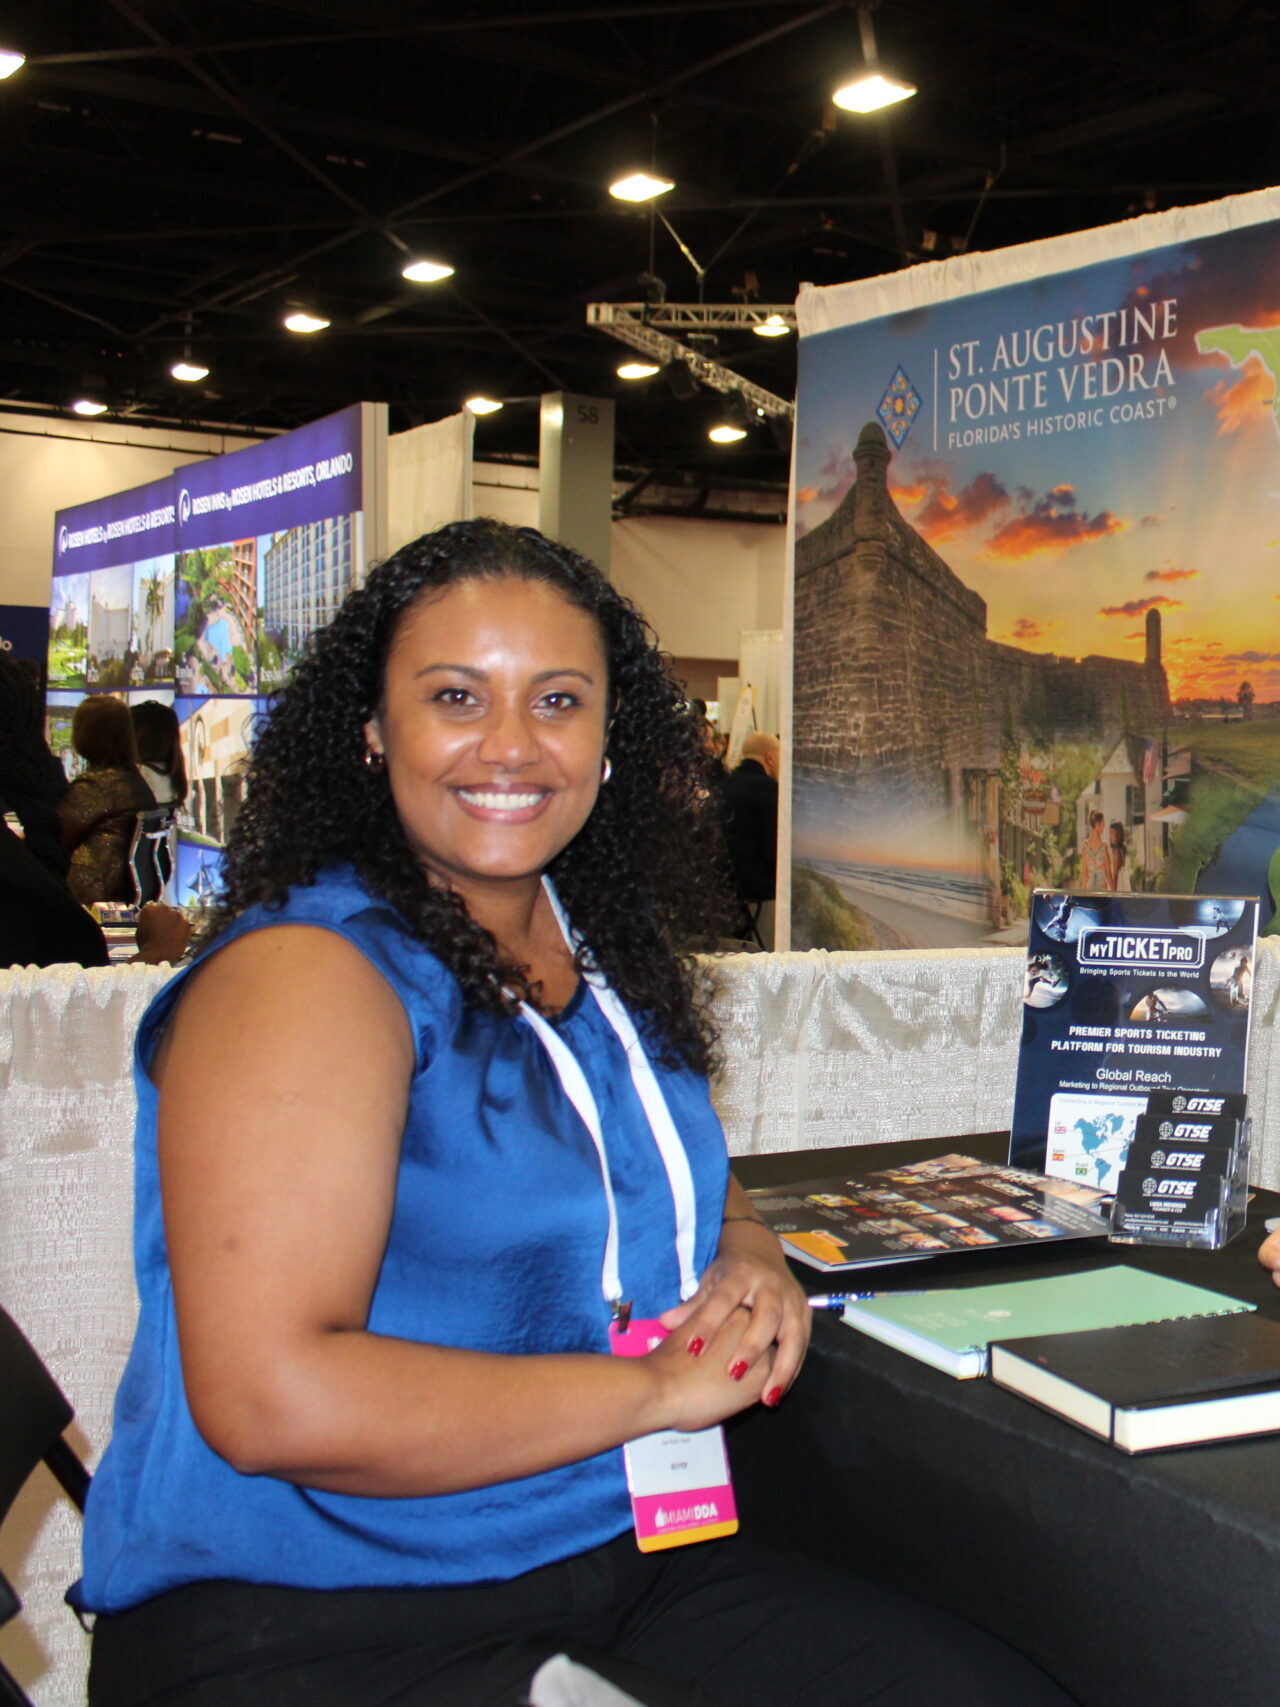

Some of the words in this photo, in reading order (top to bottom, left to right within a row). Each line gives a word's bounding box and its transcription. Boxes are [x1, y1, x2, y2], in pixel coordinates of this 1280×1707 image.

[948, 340, 983, 381] ST.
[991, 298, 1178, 372] AUGUSTINE
[949, 370, 1048, 423] PONTE
[1057, 347, 1176, 403] VEDRA
[577, 404, 599, 424] 58
[949, 421, 1021, 449] FLORIDA'S
[1027, 408, 1104, 437] HISTORIC
[252, 477, 278, 501] HOTELS
[315, 452, 353, 482] ORLANDO
[1080, 967, 1107, 976] Bringing
[1109, 968, 1131, 977] Sports
[1132, 969, 1156, 977] Tickets
[1167, 970, 1178, 978] the
[1180, 971, 1200, 979] World
[1069, 1026, 1112, 1037] PREMIER
[1114, 1027, 1153, 1039] SPORTS
[1156, 1029, 1206, 1042] TICKETING
[1051, 1040, 1103, 1051] PLATFORM
[1105, 1043, 1125, 1053] FOR
[1128, 1044, 1171, 1055] TOURISM
[1173, 1045, 1222, 1058] INDUSTRY
[1096, 1068, 1132, 1081] Global
[1135, 1070, 1172, 1083] Reach
[1059, 1080, 1090, 1090] Marketing
[1091, 1081, 1098, 1089] to
[1099, 1082, 1128, 1092] Regional
[1187, 1098, 1225, 1112] GTSE
[1174, 1124, 1213, 1138] GTSE
[1166, 1152, 1205, 1167] GTSE
[1157, 1180, 1197, 1195] GTSE
